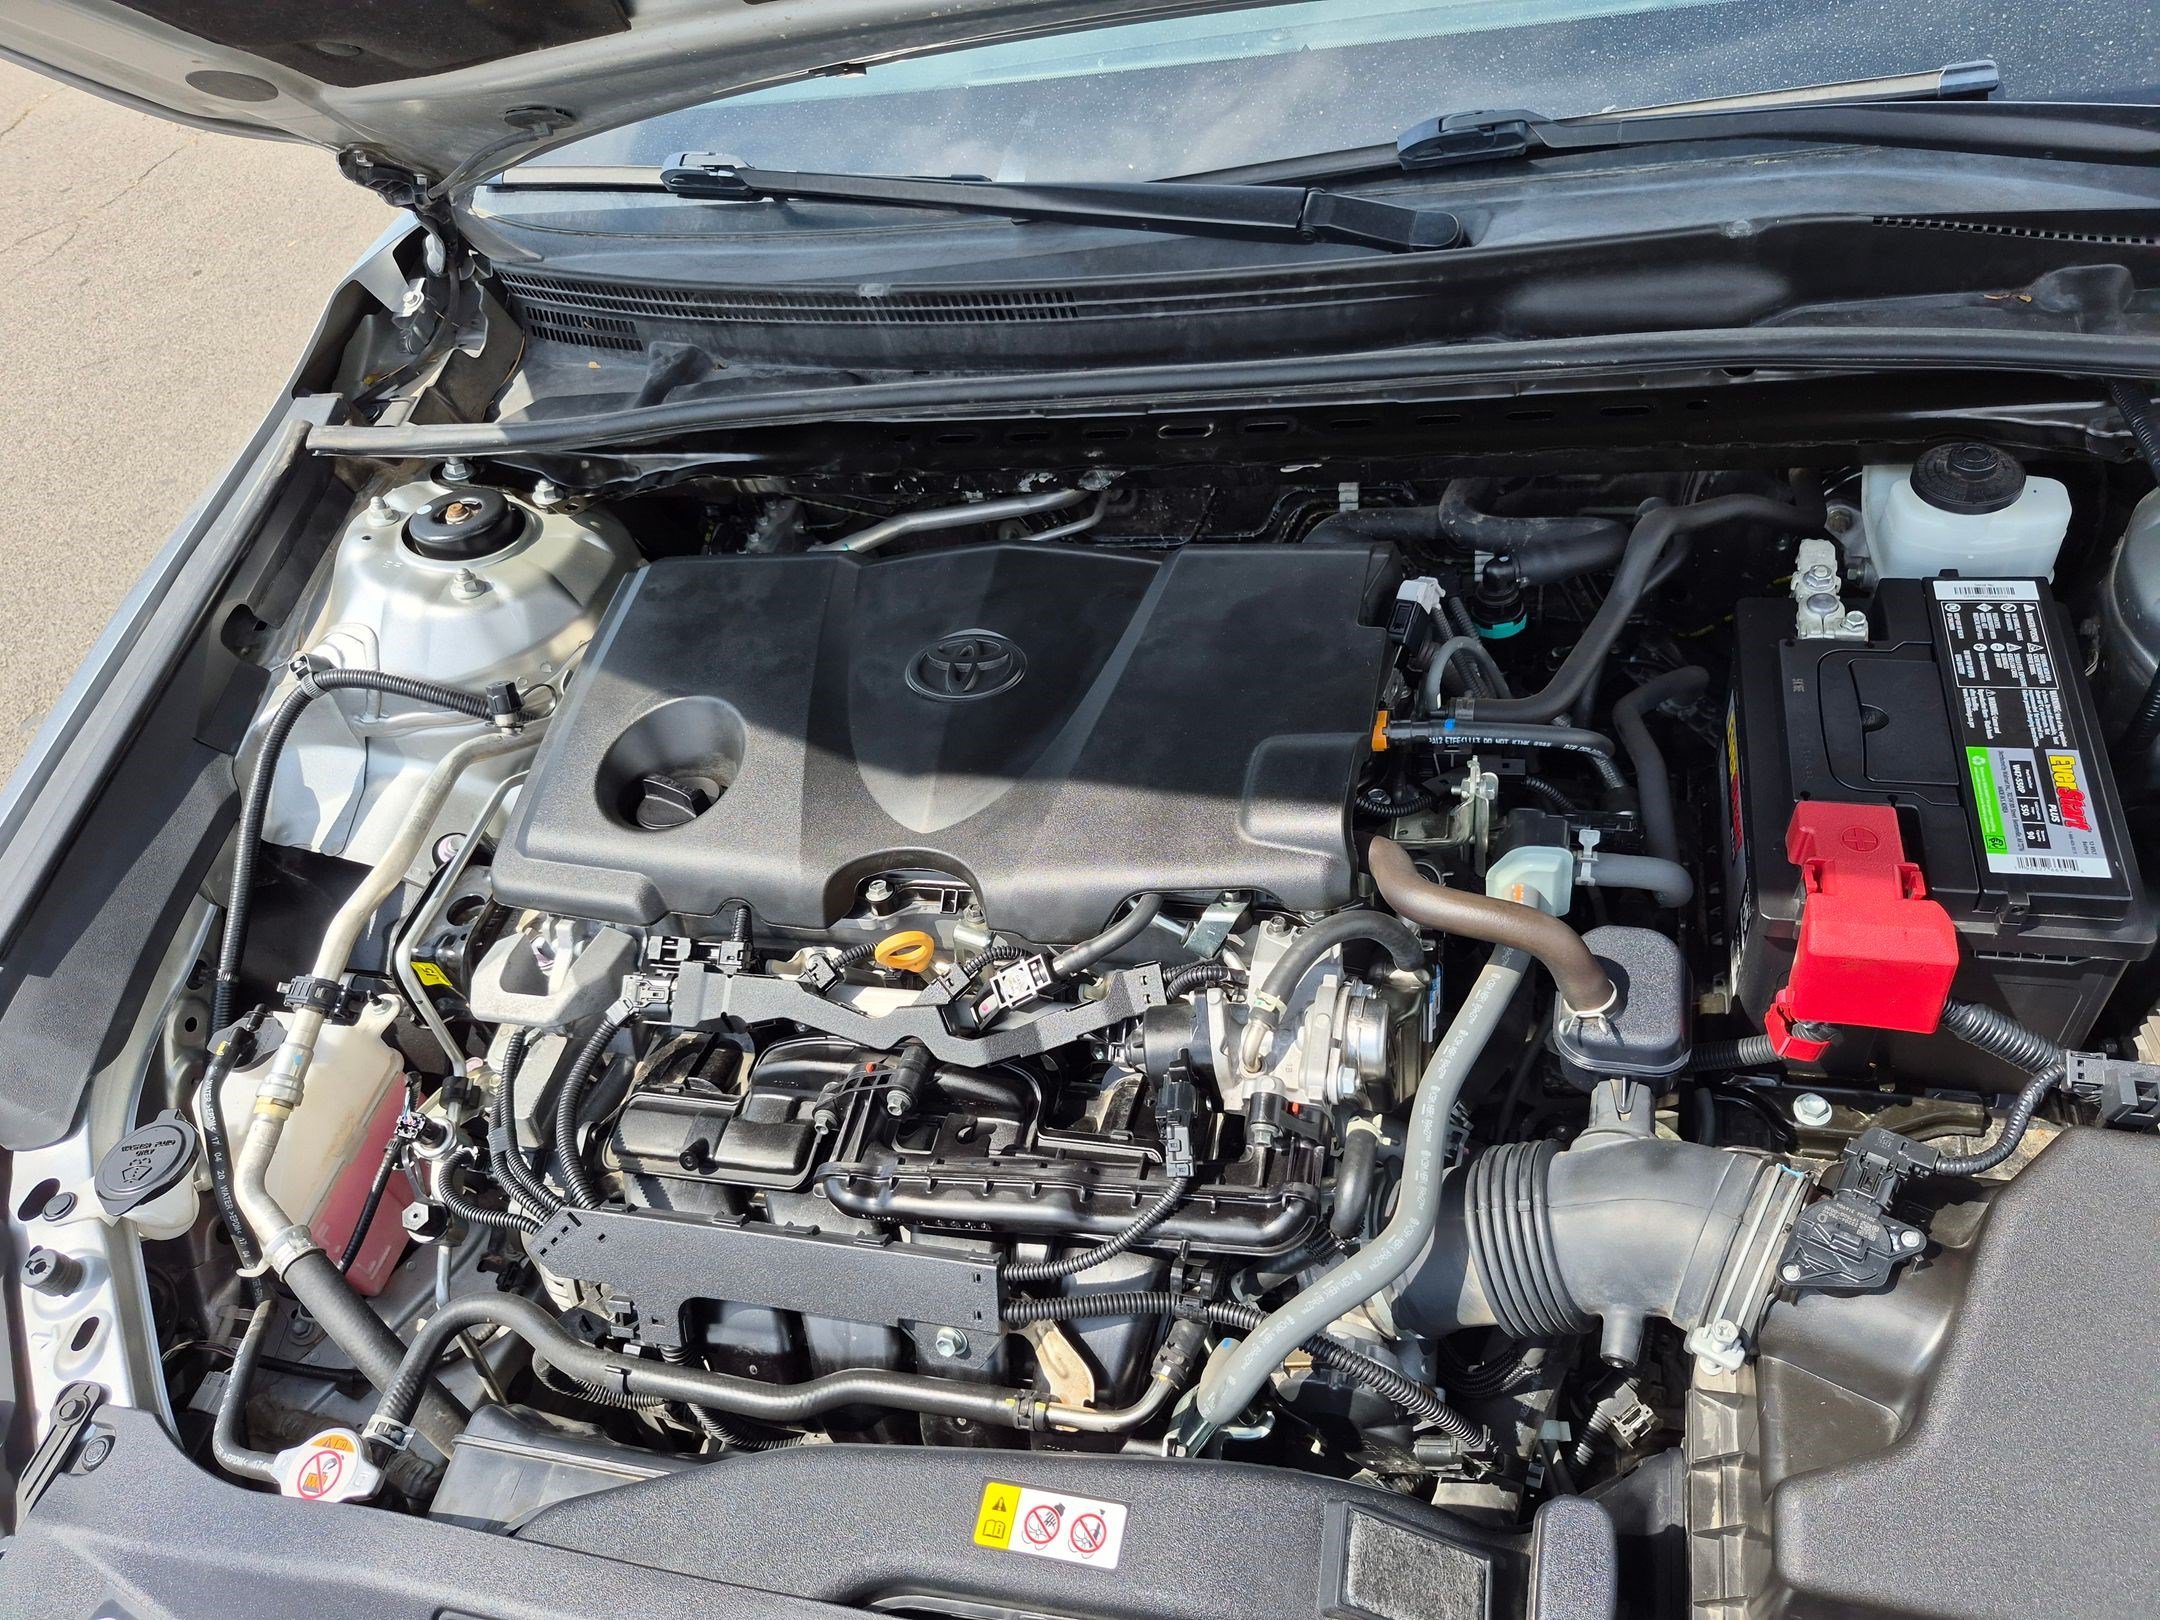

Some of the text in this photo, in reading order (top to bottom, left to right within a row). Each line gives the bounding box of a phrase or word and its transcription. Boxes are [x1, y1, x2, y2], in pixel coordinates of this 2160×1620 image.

[2048, 755, 2092, 832] EverStart
[2020, 804, 2030, 816] 550
[2048, 804, 2060, 823] PLUS
[2026, 831, 2035, 841] 90
[204, 1080, 213, 1102] WATER
[211, 1136, 220, 1145] 17
[214, 1152, 222, 1162] 04
[217, 1170, 225, 1180] 20
[220, 1185, 233, 1209] WATER
